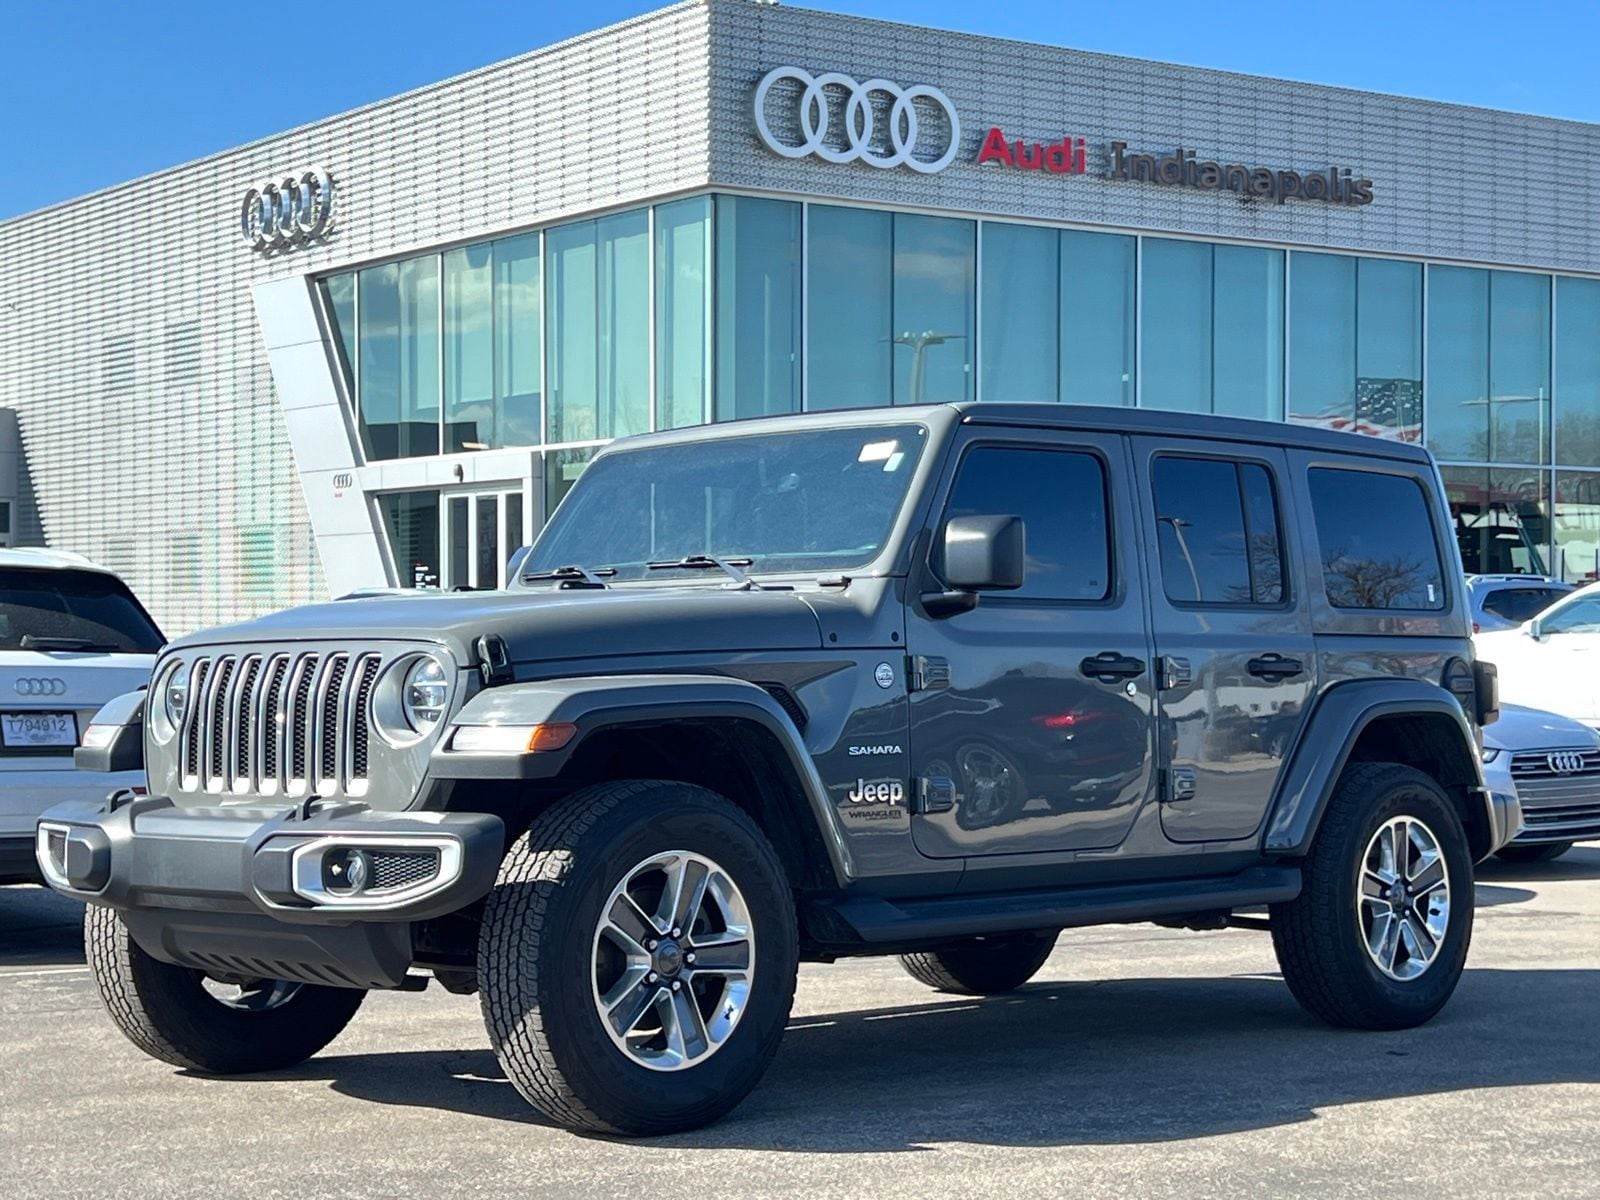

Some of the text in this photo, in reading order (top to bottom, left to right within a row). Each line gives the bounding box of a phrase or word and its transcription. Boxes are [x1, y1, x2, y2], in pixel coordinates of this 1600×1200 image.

[977, 126, 1375, 205] Audi Indianapolis
[7, 719, 66, 732] T794912
[848, 745, 902, 756] SAHARA
[849, 778, 903, 806] Jeep
